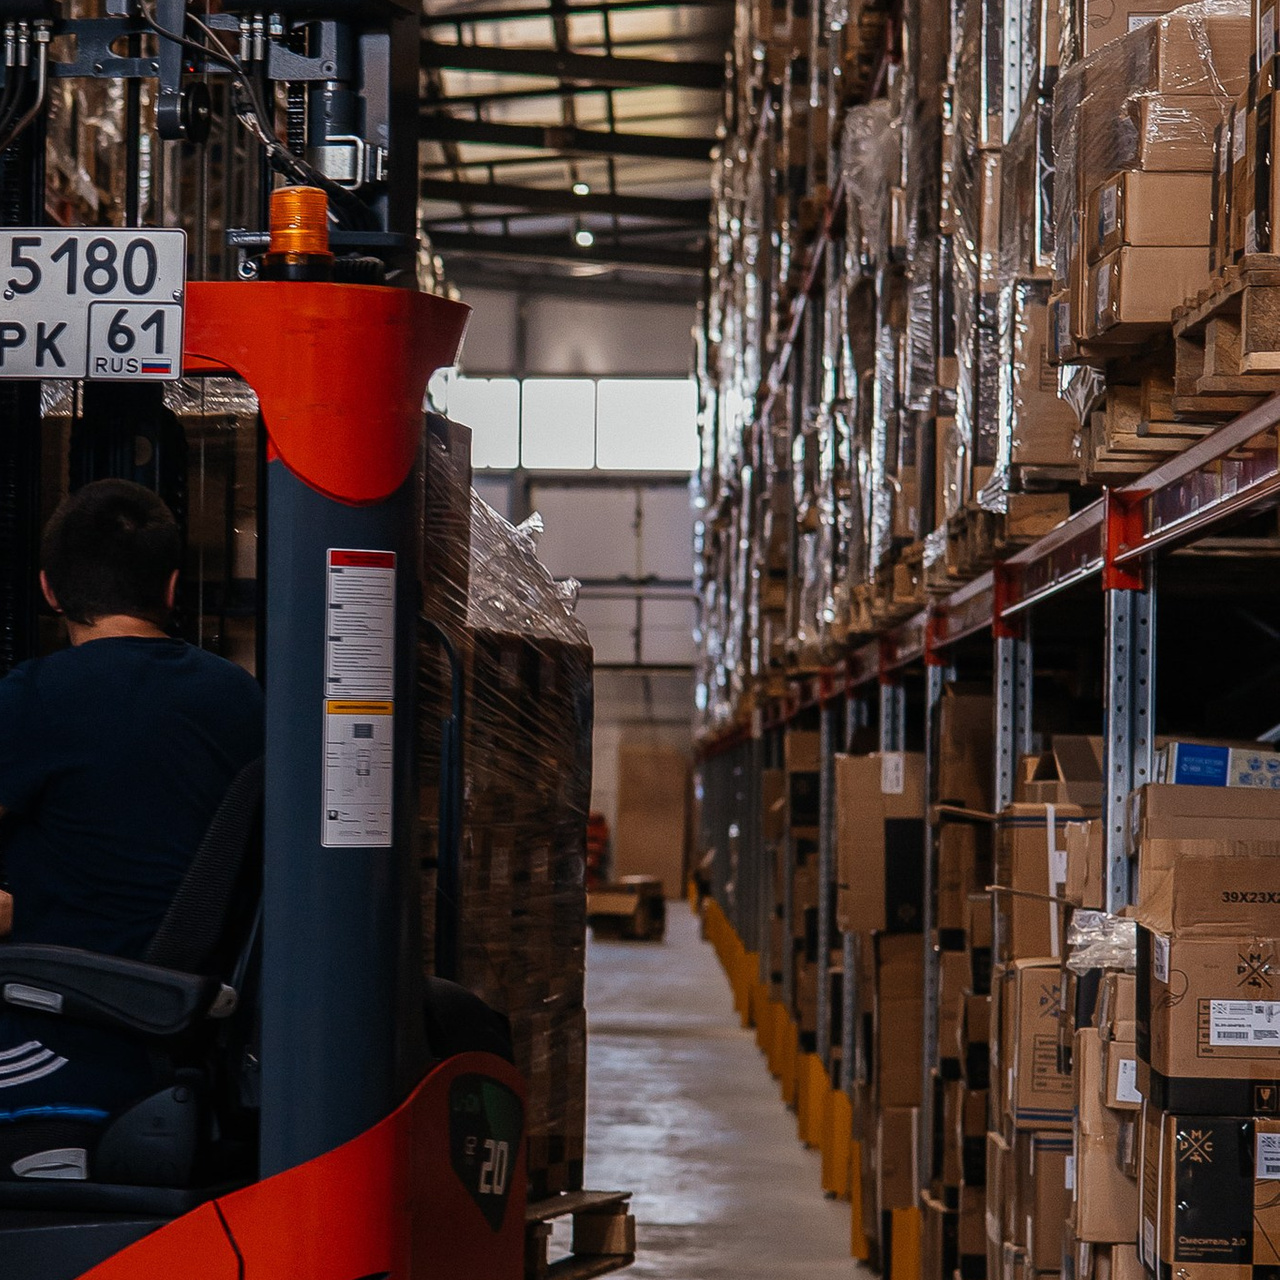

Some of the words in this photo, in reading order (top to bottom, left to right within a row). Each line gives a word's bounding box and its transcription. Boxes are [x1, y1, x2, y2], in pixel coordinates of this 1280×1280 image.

[7, 236, 158, 296] 5180
[107, 308, 166, 355] 61
[95, 357, 139, 374] RUS
[478, 1138, 508, 1195] 20
[1231, 1237, 1247, 1247] 2.0
